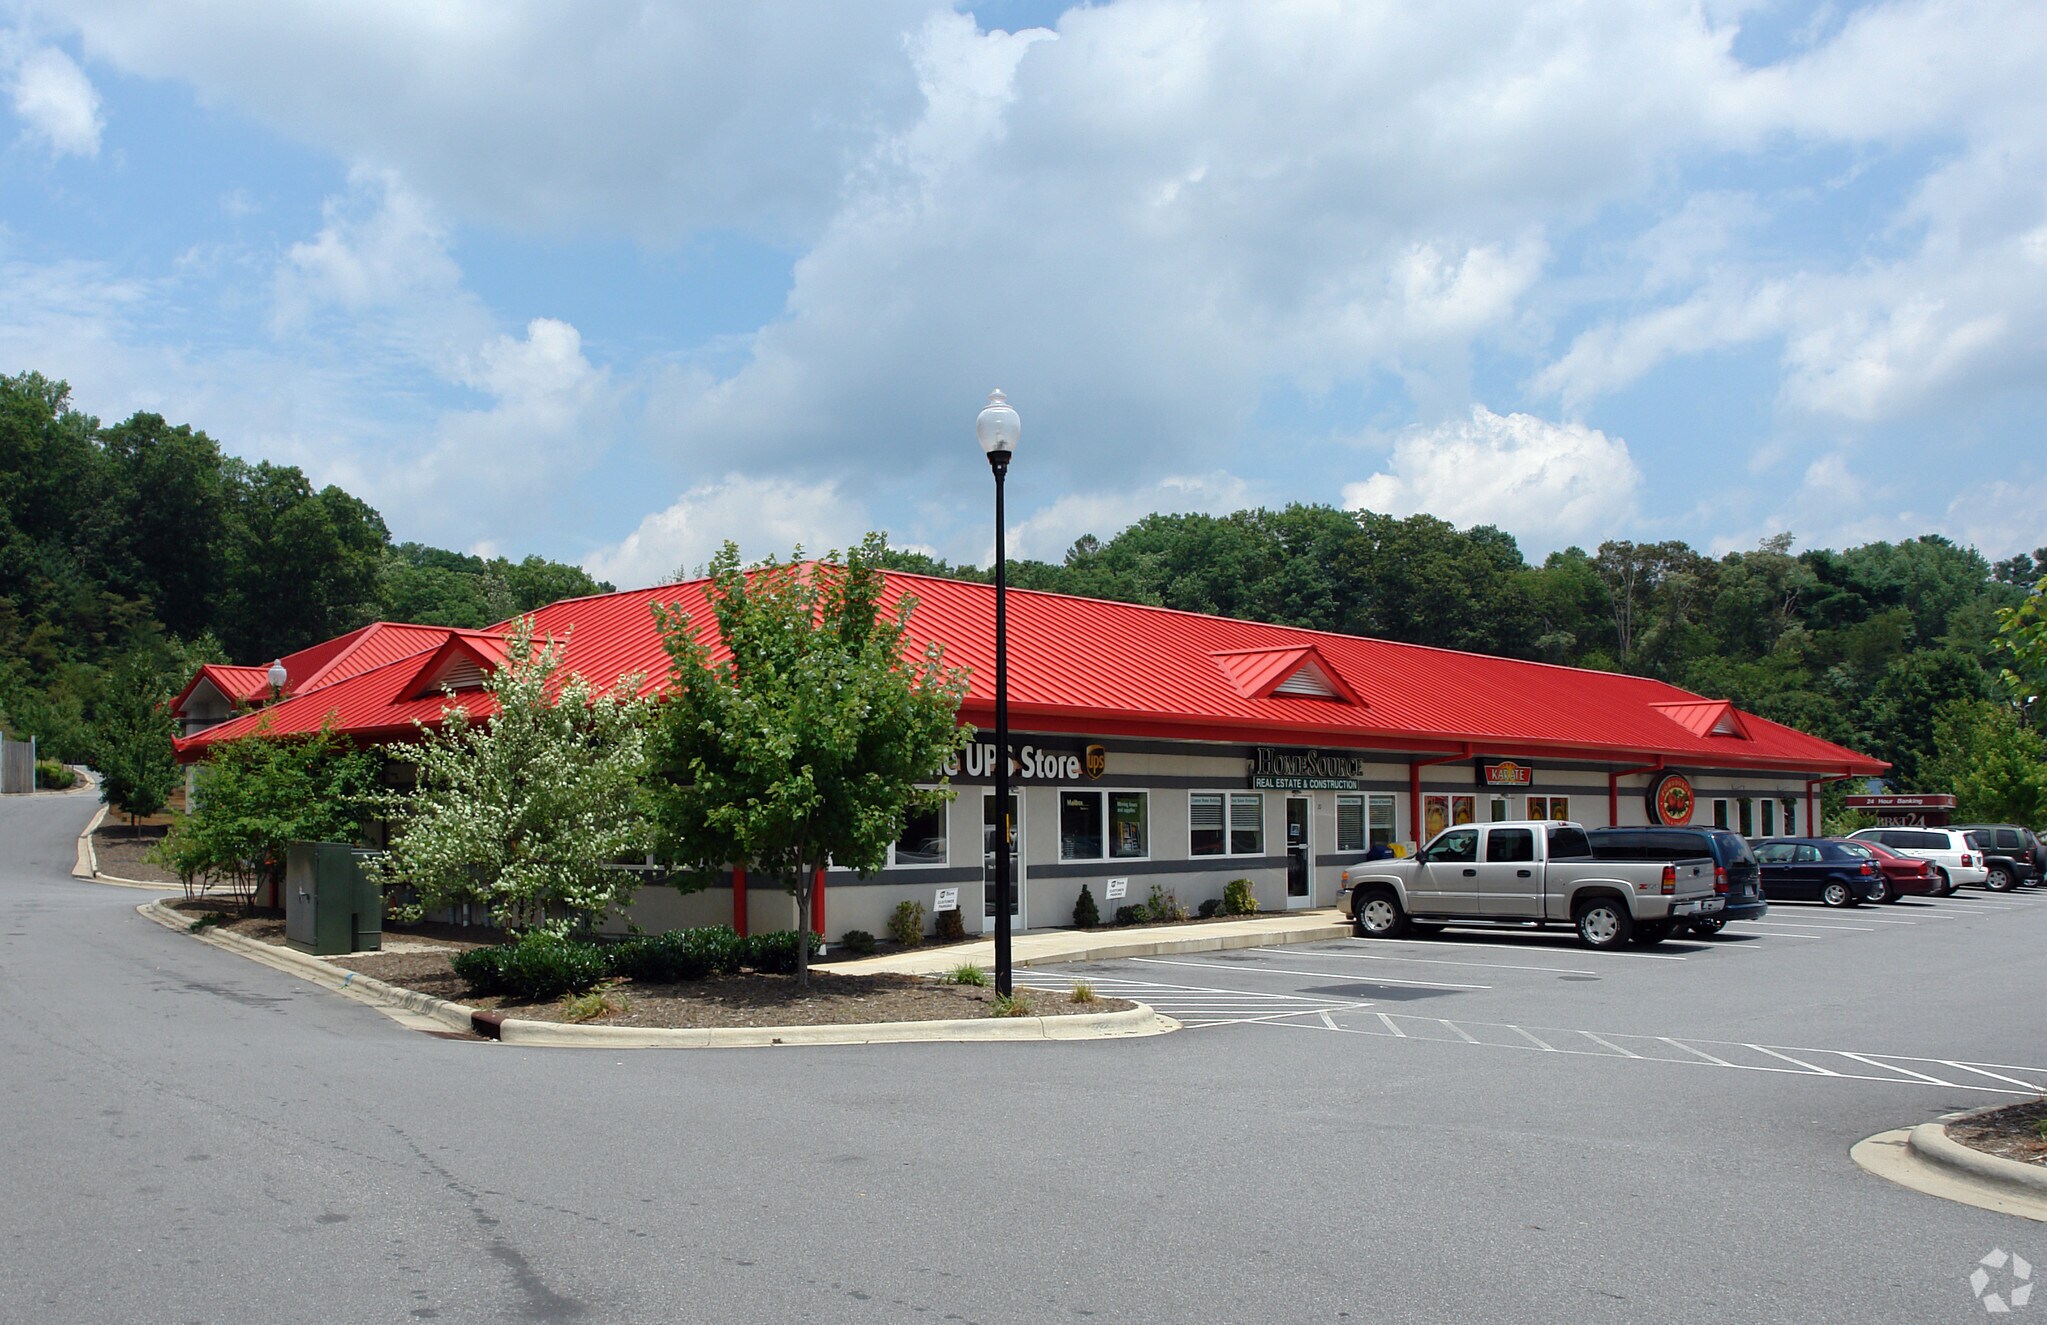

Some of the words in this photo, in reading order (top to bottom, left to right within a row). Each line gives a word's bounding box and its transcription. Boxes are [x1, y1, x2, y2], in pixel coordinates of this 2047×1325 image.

[1021, 745, 1080, 779] Store
[1087, 754, 1106, 774] ups
[1491, 768, 1525, 781] KARATE
[1256, 777, 1274, 788] REAL
[1276, 778, 1301, 788] ESTATE
[1303, 779, 1308, 788] &
[1309, 779, 1357, 790] CONSTRUCTION
